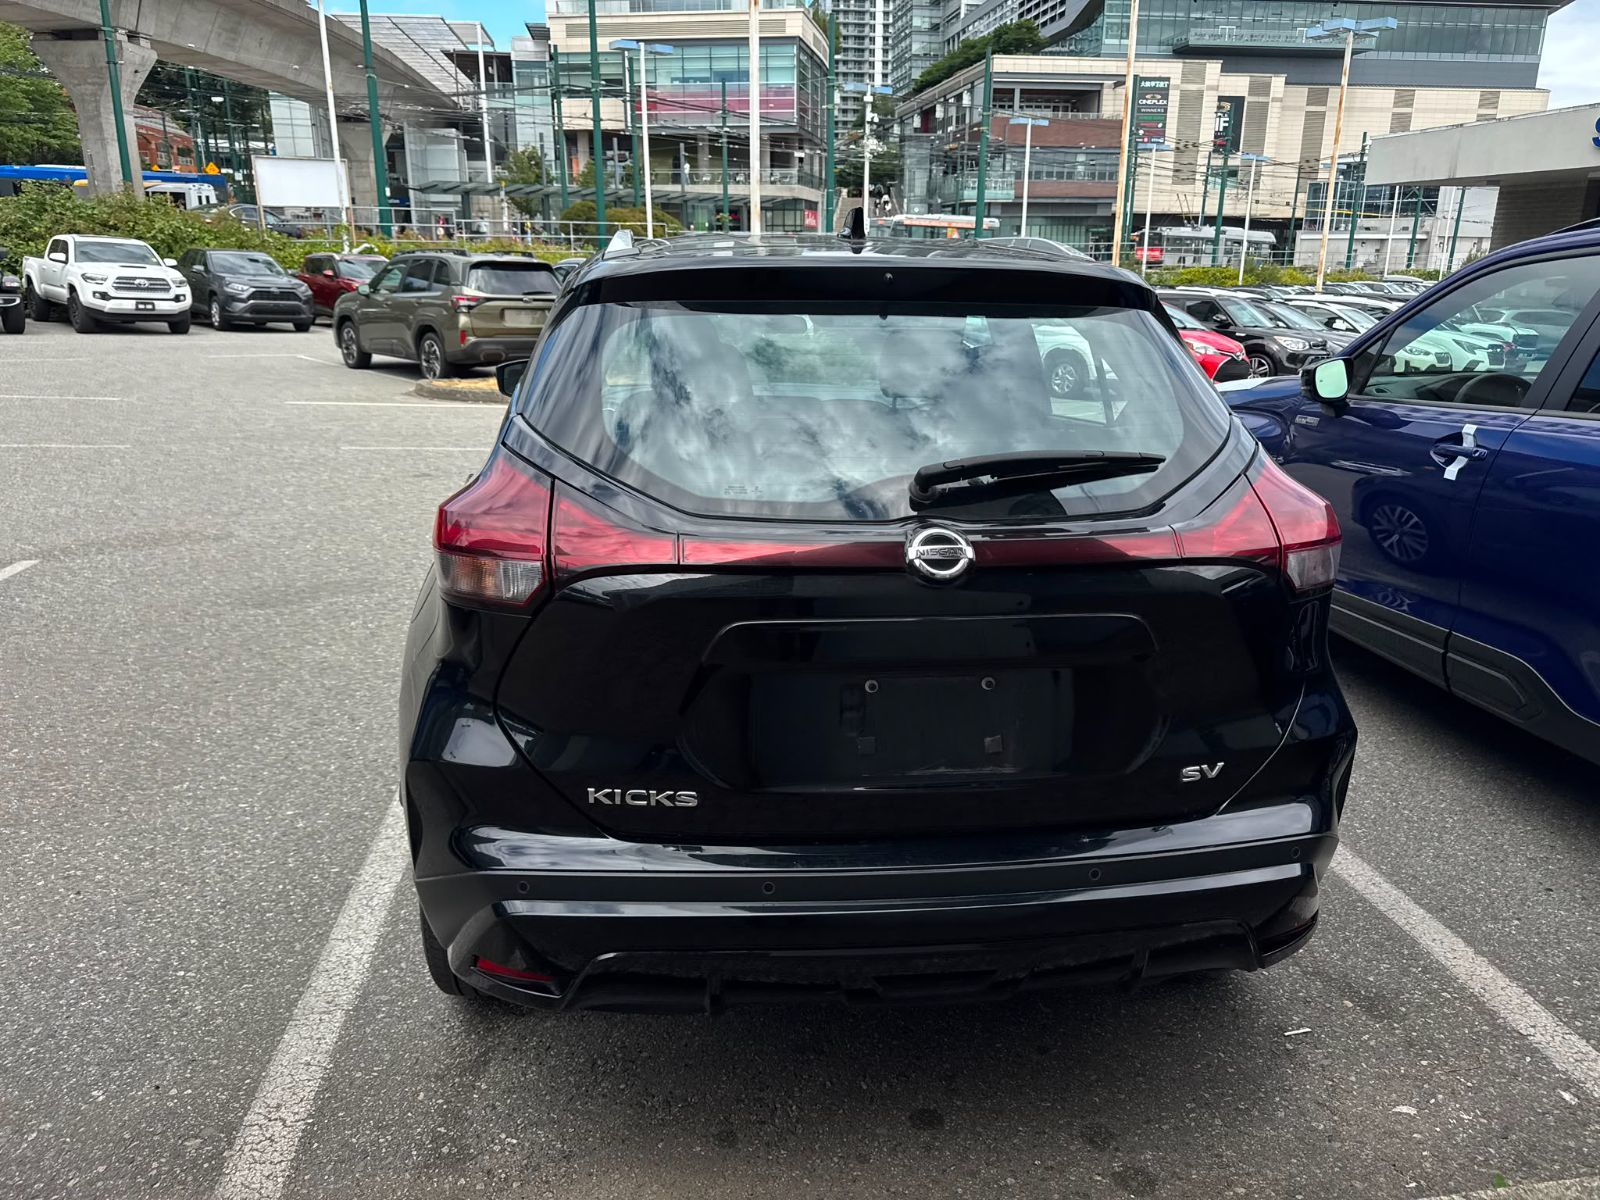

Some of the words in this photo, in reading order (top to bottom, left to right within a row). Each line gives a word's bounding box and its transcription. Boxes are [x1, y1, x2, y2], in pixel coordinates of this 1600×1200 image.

[916, 547, 966, 557] NISSAN
[1182, 761, 1225, 783] SV
[587, 787, 698, 807] KICKS
